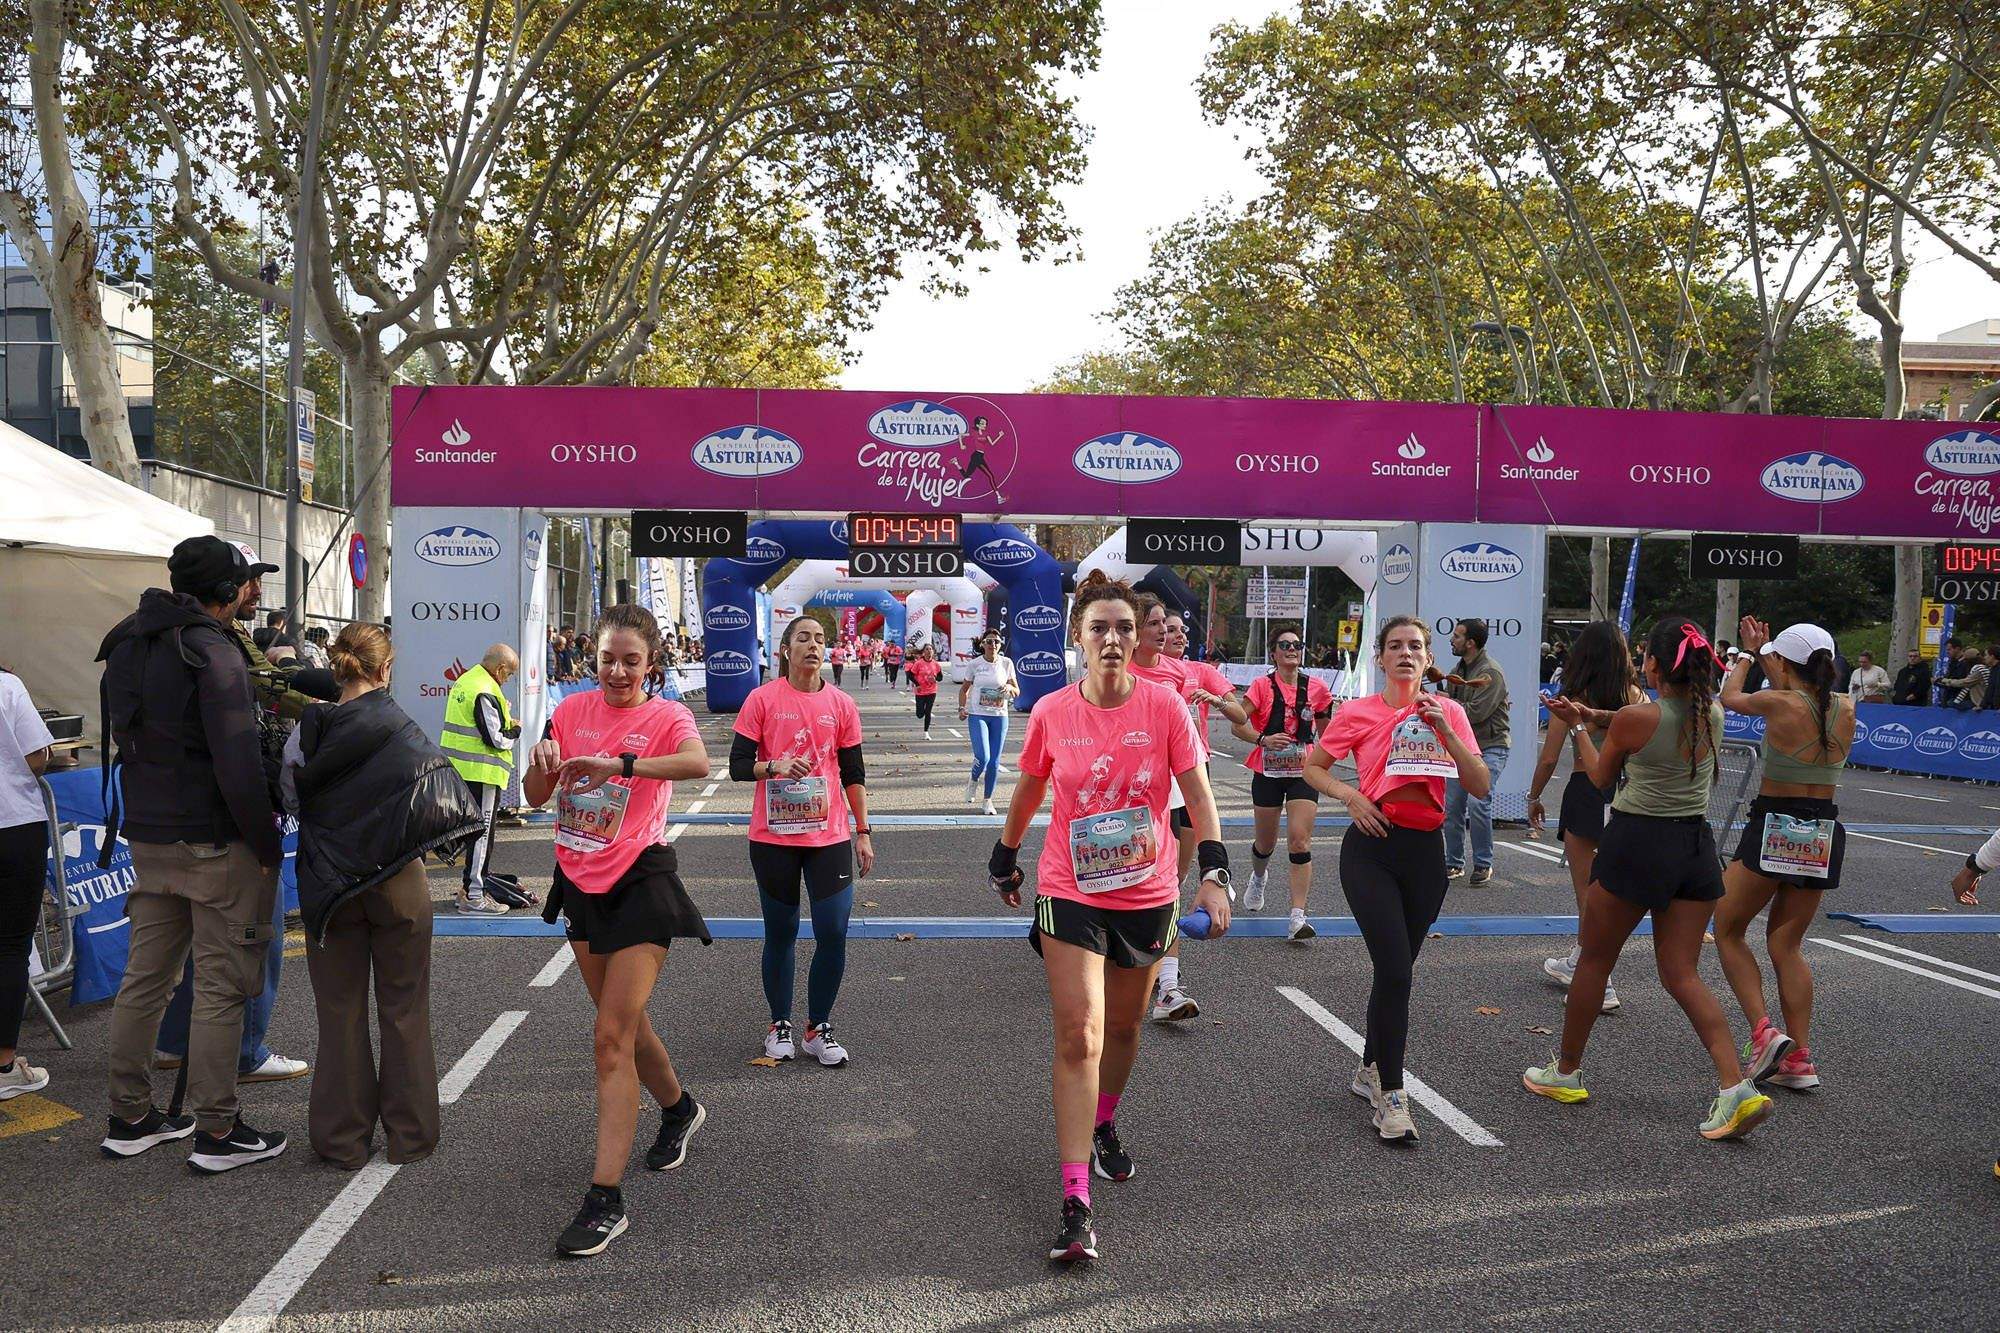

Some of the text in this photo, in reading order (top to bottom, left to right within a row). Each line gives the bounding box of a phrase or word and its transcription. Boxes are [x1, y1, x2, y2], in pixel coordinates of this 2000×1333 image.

[299, 404, 306, 428] P
[875, 416, 960, 436] ASTURIANA
[415, 448, 497, 463] Santander
[551, 444, 637, 463] OYSHO
[701, 443, 795, 464] ASTURIANA
[857, 442, 941, 470] Carrera
[1081, 449, 1174, 470] ASTURIANA
[1931, 446, 2000, 465] ASTURIAN
[1235, 453, 1319, 473] OYSHO
[1371, 461, 1451, 477] Santander
[1500, 464, 1580, 480] Santander
[1629, 464, 1711, 485] OYSHO
[1768, 469, 1856, 491] ASTURIANA
[877, 466, 971, 507] de la Mujer
[1914, 471, 1990, 498] Carrera
[1931, 494, 2000, 534] de la Muje
[649, 525, 731, 545] OYSHO
[855, 518, 955, 543] 00:45:49
[421, 541, 494, 557] ASTURIANA
[1145, 534, 1225, 552] OYSHO
[747, 549, 781, 558] TURIANA
[980, 550, 1032, 560] ASTURIANA
[1708, 547, 1783, 567] OYSHO
[854, 552, 958, 574] OYSHO
[1384, 561, 1411, 576] ASTURIANA
[1446, 556, 1517, 573] ASTURIANA
[816, 590, 854, 605] Marlene
[411, 602, 500, 621] OYSHO
[706, 616, 748, 625] ASTURIANA
[1436, 617, 1522, 637] OHO
[708, 660, 750, 670] ASTURIANA
[1059, 736, 1093, 746] OYSHO
[1408, 742, 1434, 752] 016
[1872, 731, 1909, 745] ASTURIANA
[1916, 736, 1953, 749] ASTURIANA
[571, 806, 597, 824] 016
[787, 802, 810, 812] 016
[1094, 822, 1125, 833] ASTURIANA
[1100, 844, 1131, 861] 016
[1787, 842, 1811, 853] 016
[65, 850, 132, 878] ENTRA ECHE
[1109, 860, 1125, 868] 9023
[65, 866, 138, 906] STURIA
[1087, 879, 1113, 889] OYSHO
